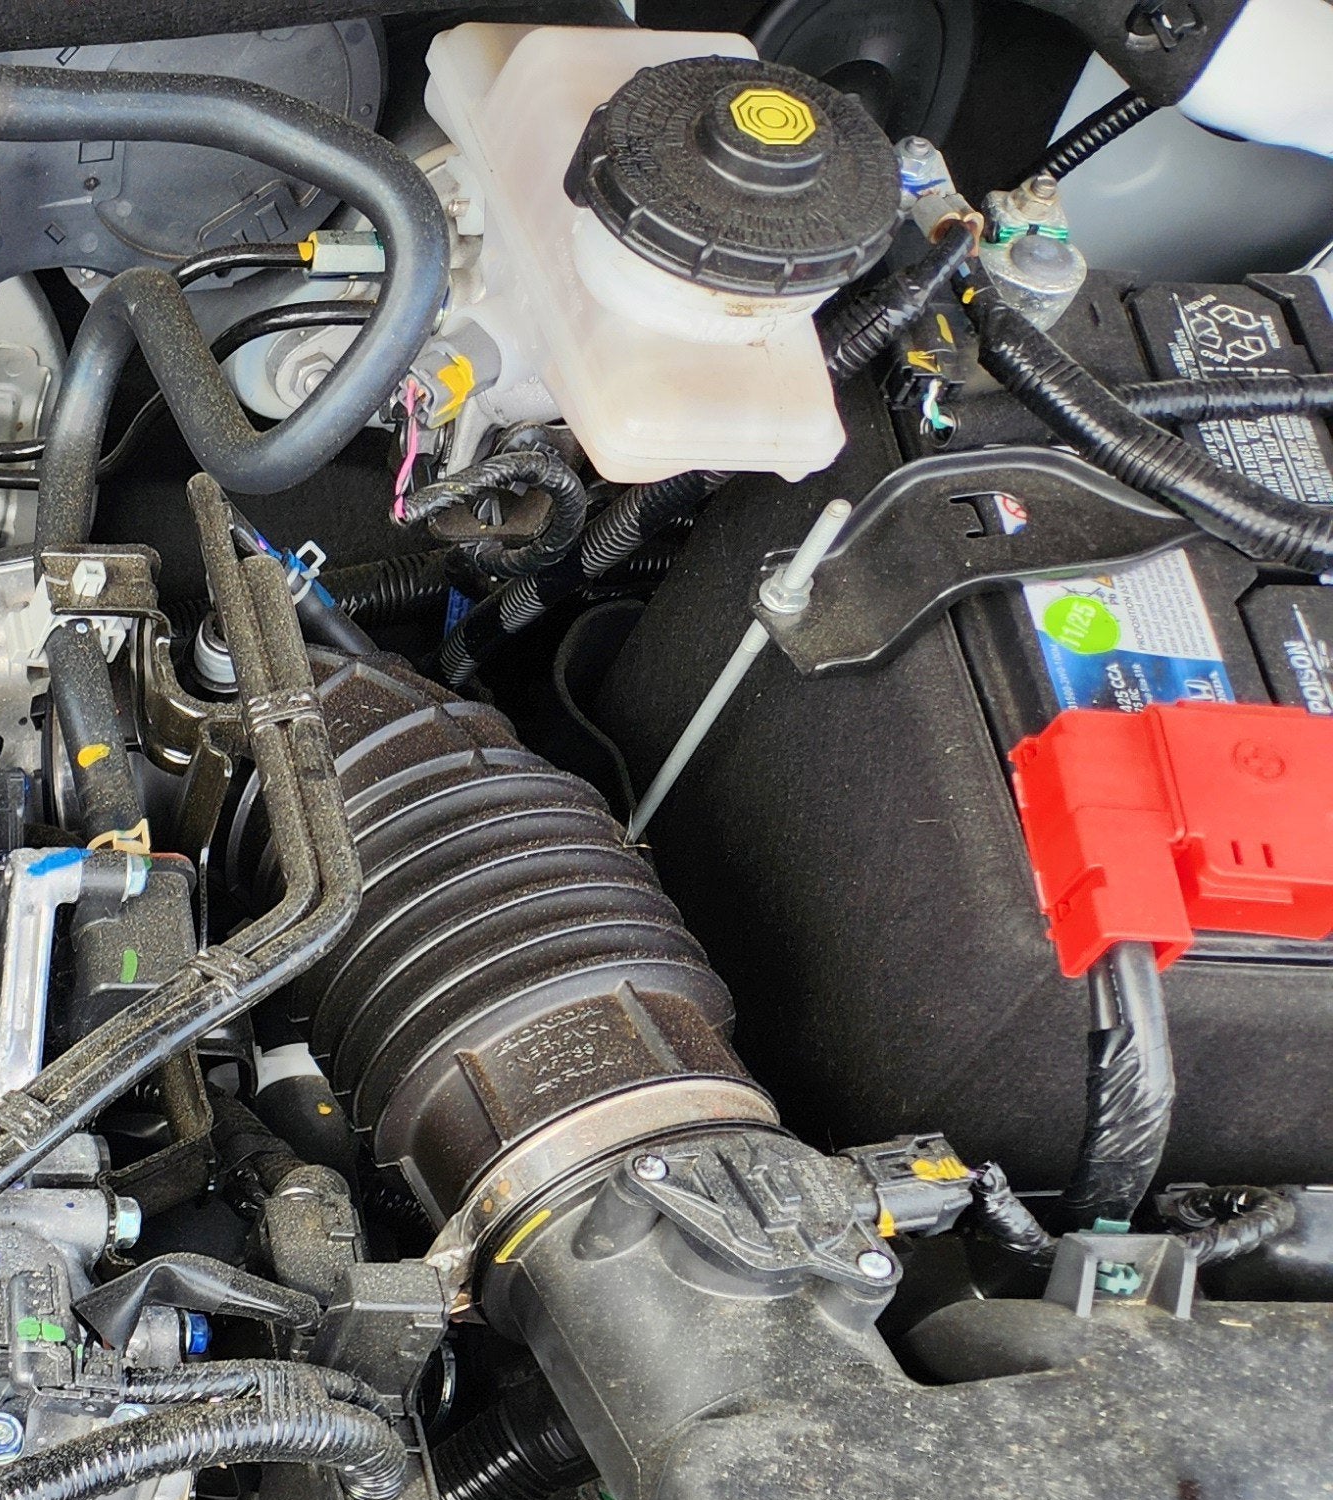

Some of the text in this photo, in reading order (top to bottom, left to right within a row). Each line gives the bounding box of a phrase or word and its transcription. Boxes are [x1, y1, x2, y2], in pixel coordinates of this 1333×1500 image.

[1063, 600, 1097, 647] 11/25
[1106, 663, 1133, 711] 425 CCA
[1284, 641, 1332, 713] POISON
